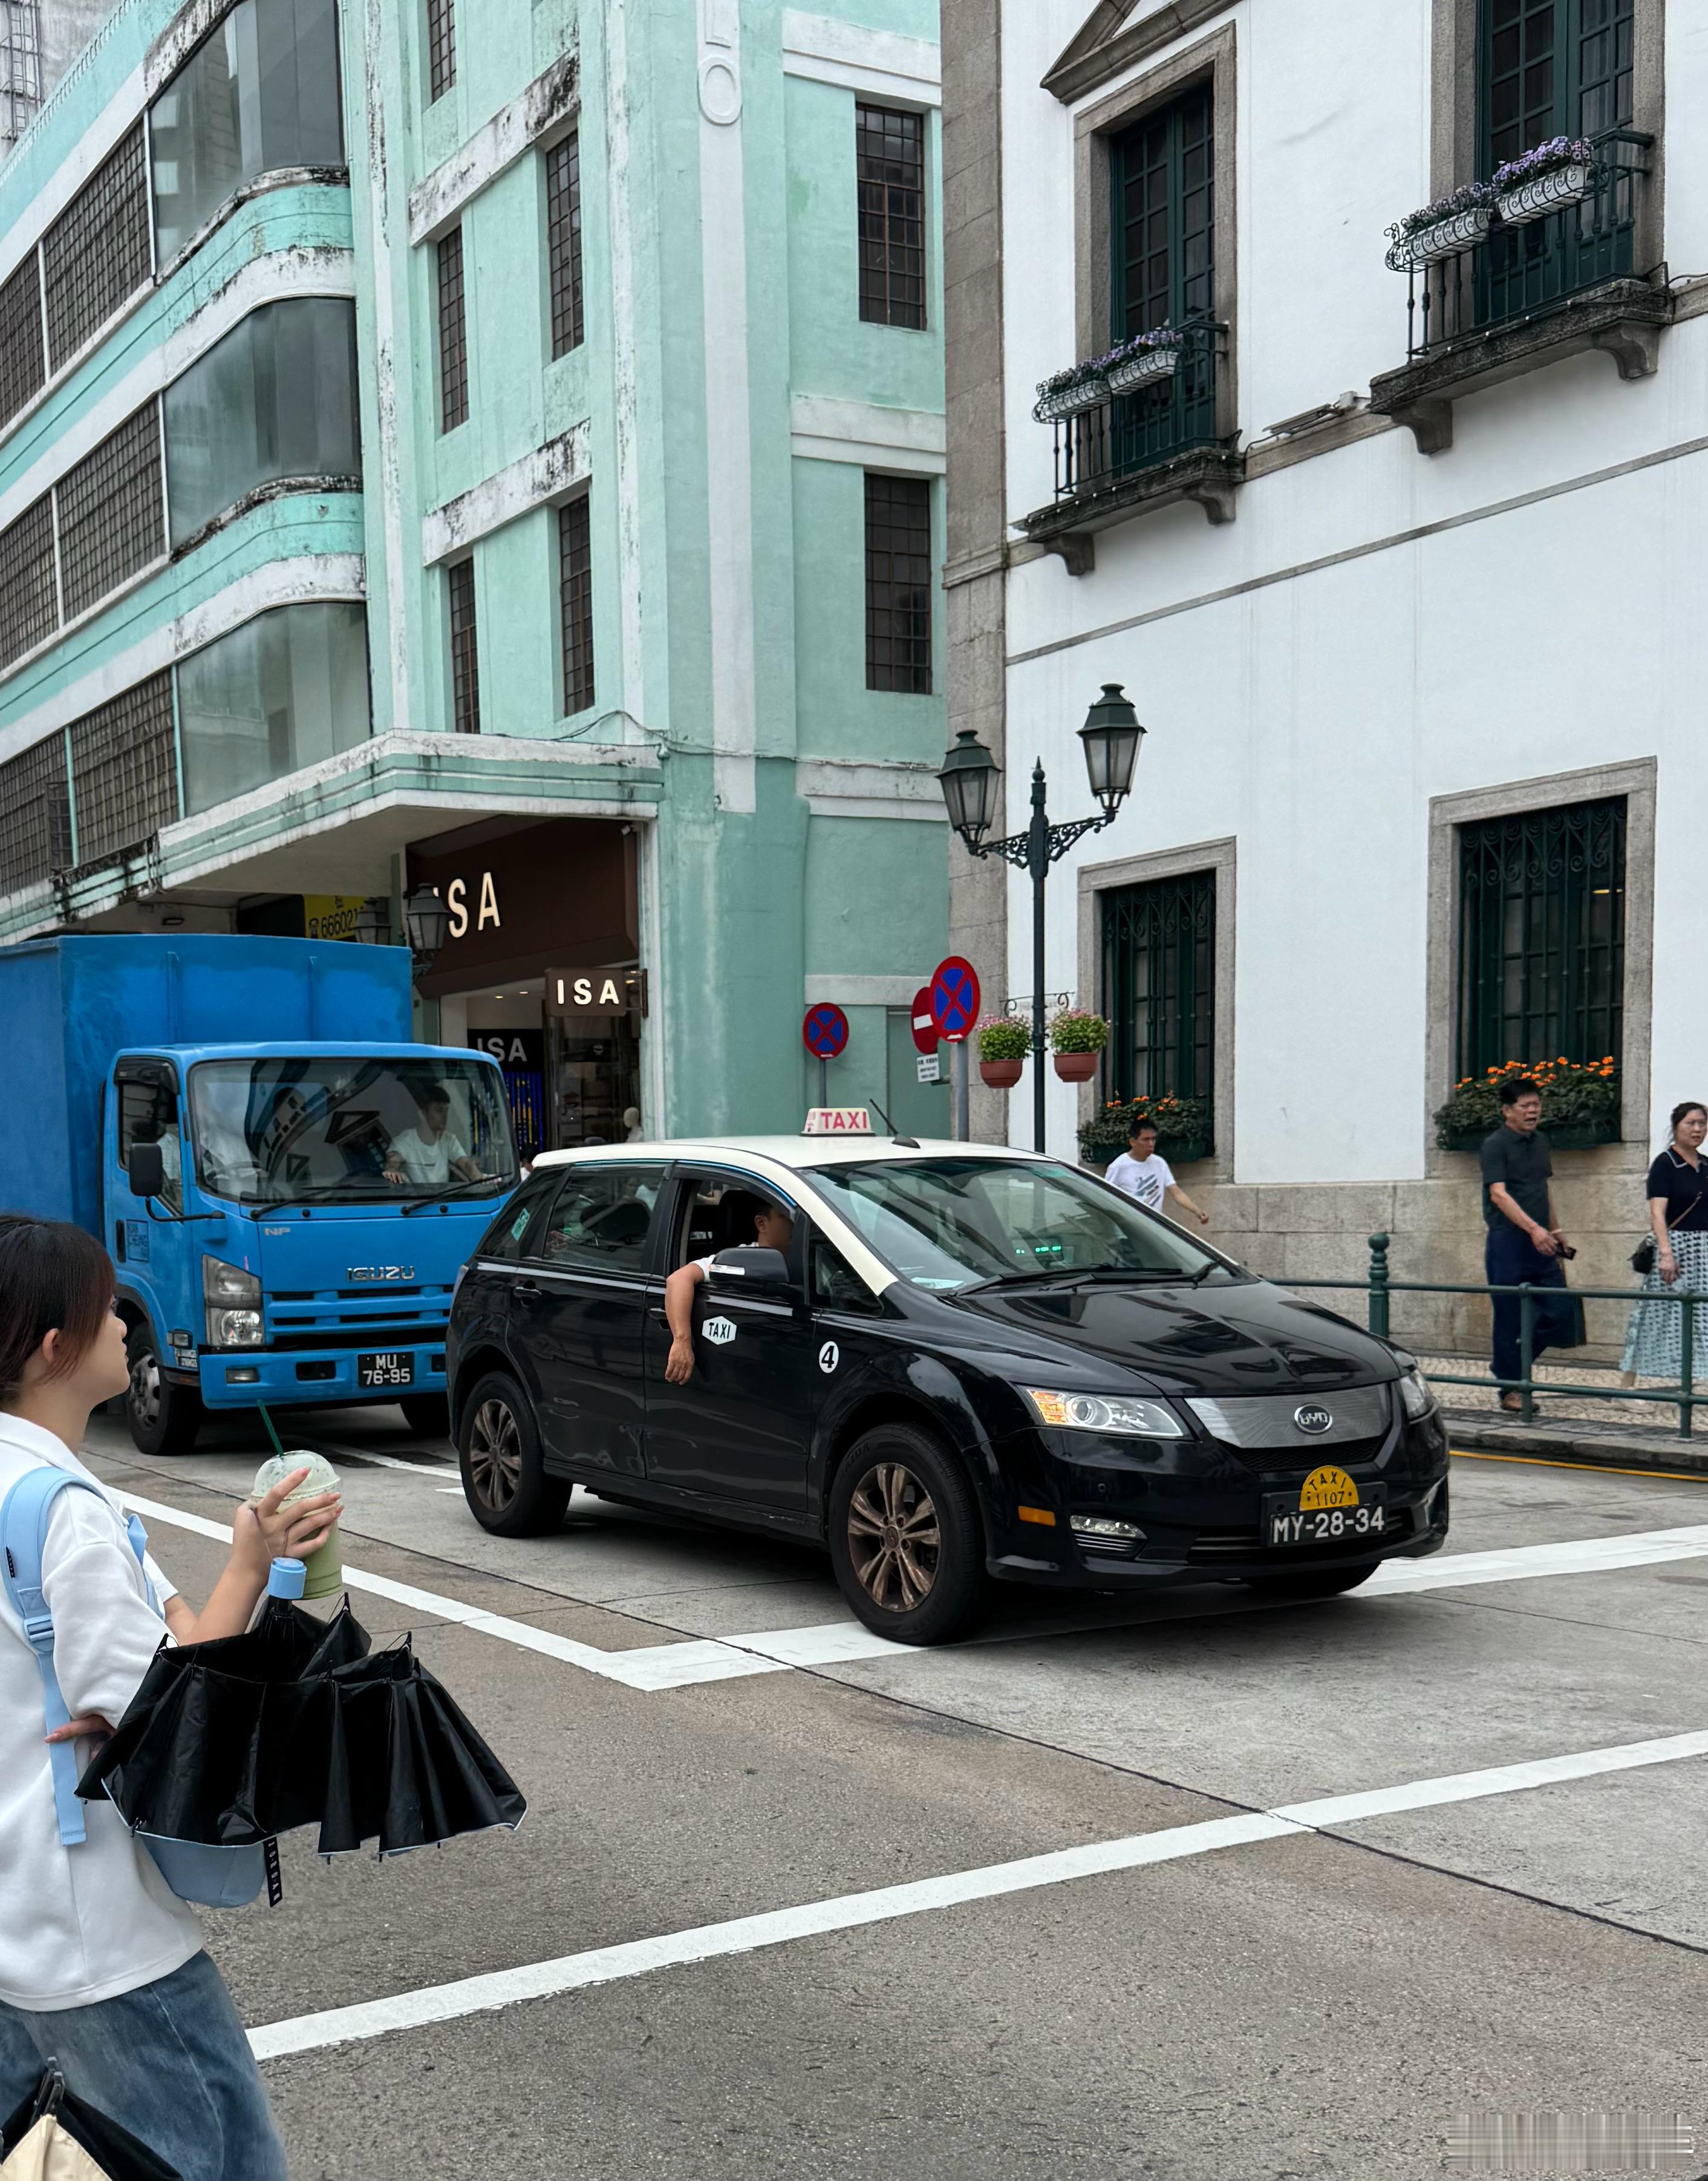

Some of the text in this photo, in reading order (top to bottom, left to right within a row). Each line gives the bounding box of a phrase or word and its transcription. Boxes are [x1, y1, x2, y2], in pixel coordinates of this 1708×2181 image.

[433, 872, 500, 938] SA
[557, 979, 619, 1005] ISA
[820, 1112, 867, 1129] TAXI
[347, 1265, 415, 1282] ISUZU
[709, 1322, 730, 1340] TAXI
[376, 1354, 397, 1369] MU
[821, 1345, 835, 1369] 4
[363, 1368, 411, 1385] 76-95
[1299, 1412, 1328, 1424] BYD
[1308, 1471, 1347, 1491] TAXI
[1317, 1491, 1345, 1506] 1107
[1273, 1506, 1384, 1543] MY-28-34
